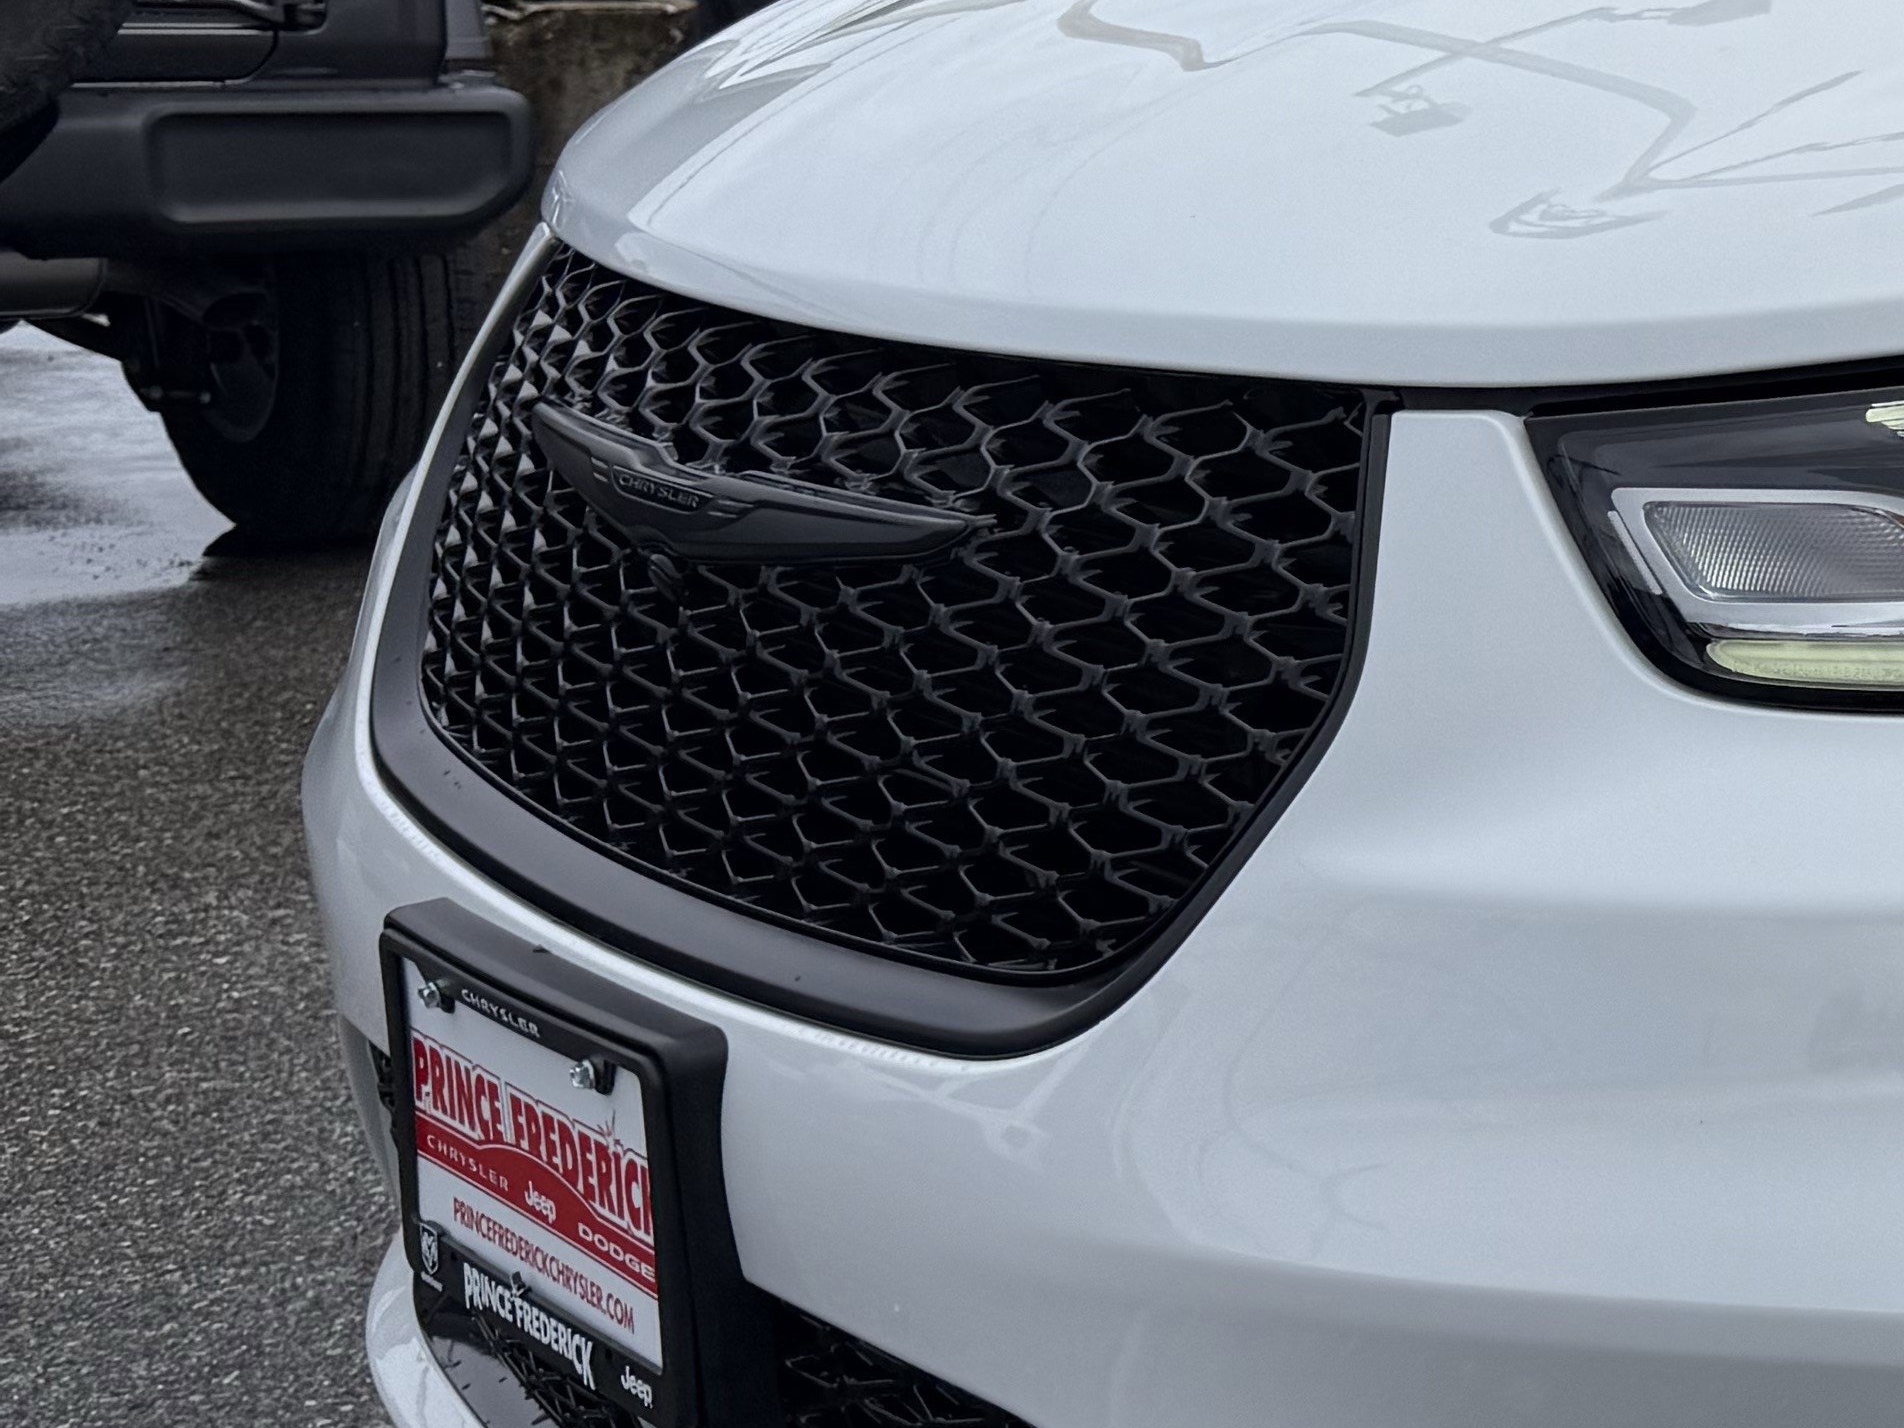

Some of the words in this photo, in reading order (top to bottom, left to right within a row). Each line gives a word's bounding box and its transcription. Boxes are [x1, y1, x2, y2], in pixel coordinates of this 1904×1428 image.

[619, 473, 700, 508] CHRYSLER
[460, 988, 541, 1039] CHRYSLER
[412, 1036, 504, 1143] PRINCE
[508, 1093, 655, 1237] FREDERIC
[426, 1134, 509, 1192] CHRYSLER
[523, 1179, 557, 1224] Jeep
[577, 1222, 656, 1279] DODGE
[453, 1196, 636, 1335] PRINCEFREDERICKCHRYSLER.COM
[462, 1261, 514, 1323] PRINCE
[515, 1298, 597, 1391] FREDERICK
[620, 1365, 654, 1410] Jeep
